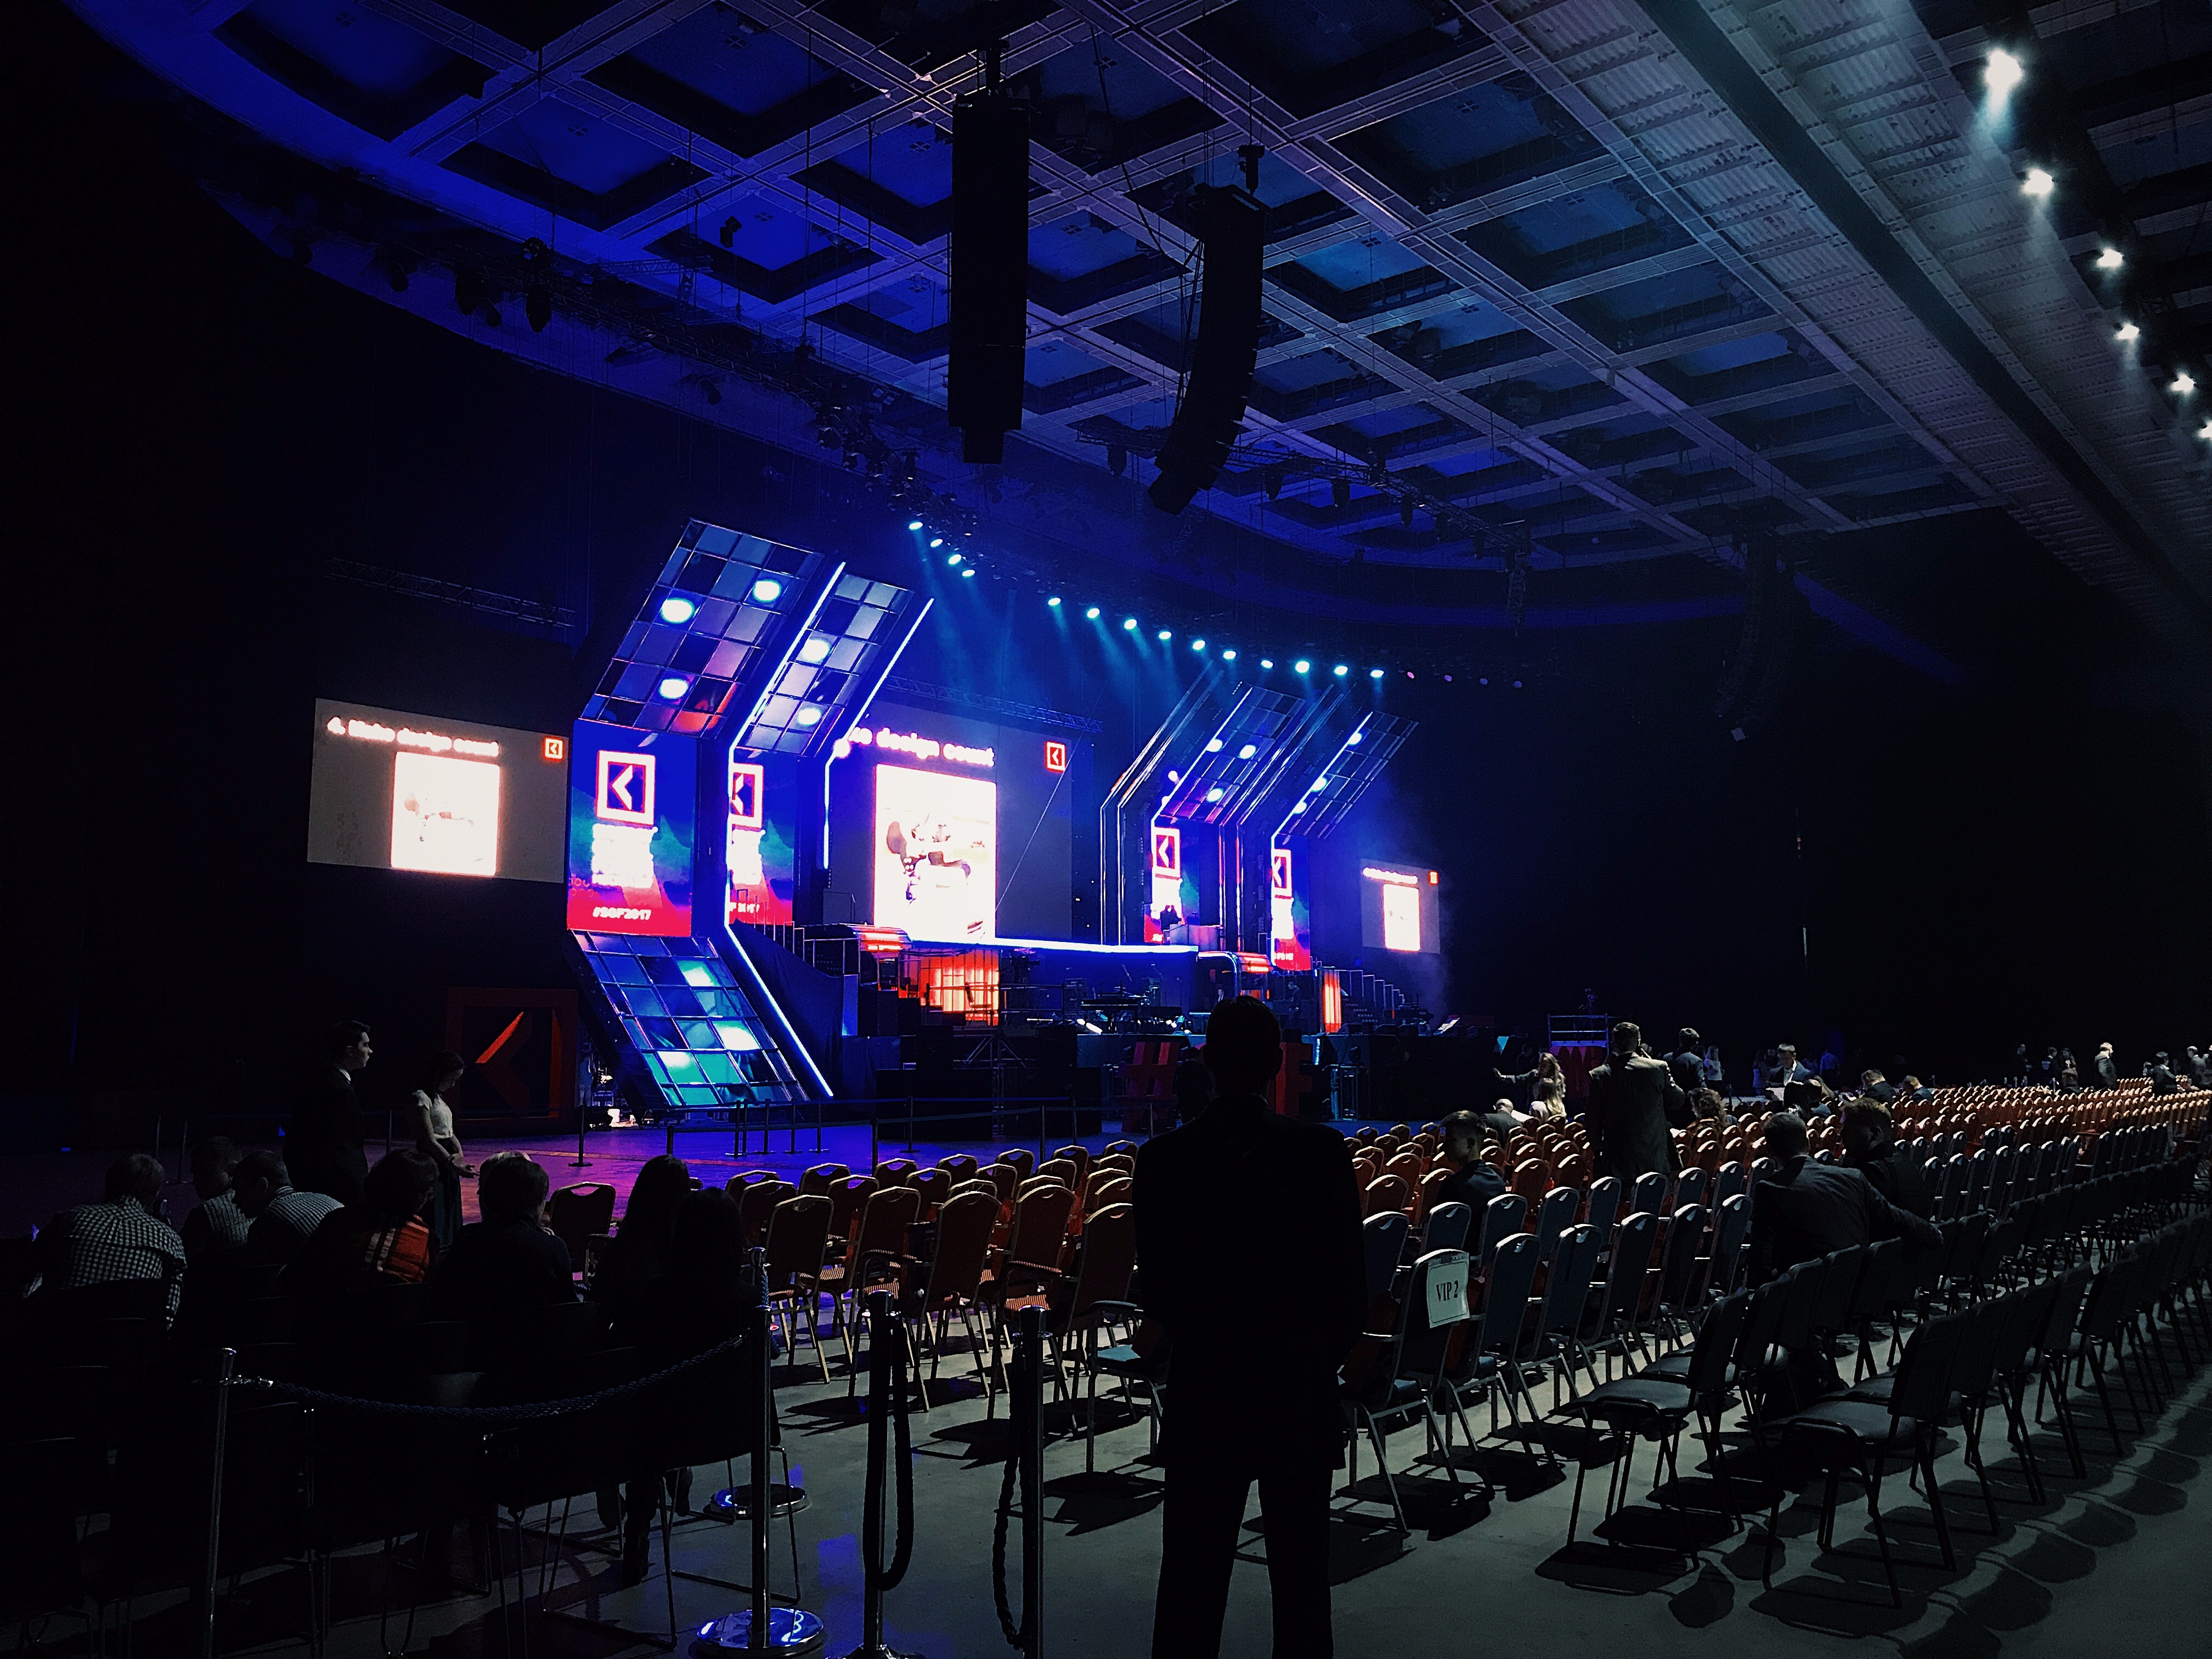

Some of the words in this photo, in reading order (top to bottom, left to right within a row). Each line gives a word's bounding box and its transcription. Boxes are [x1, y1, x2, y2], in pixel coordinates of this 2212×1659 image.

[877, 727, 940, 759] design
[1436, 1282, 1452, 1302] VIP
[1453, 1280, 1459, 1298] 2
